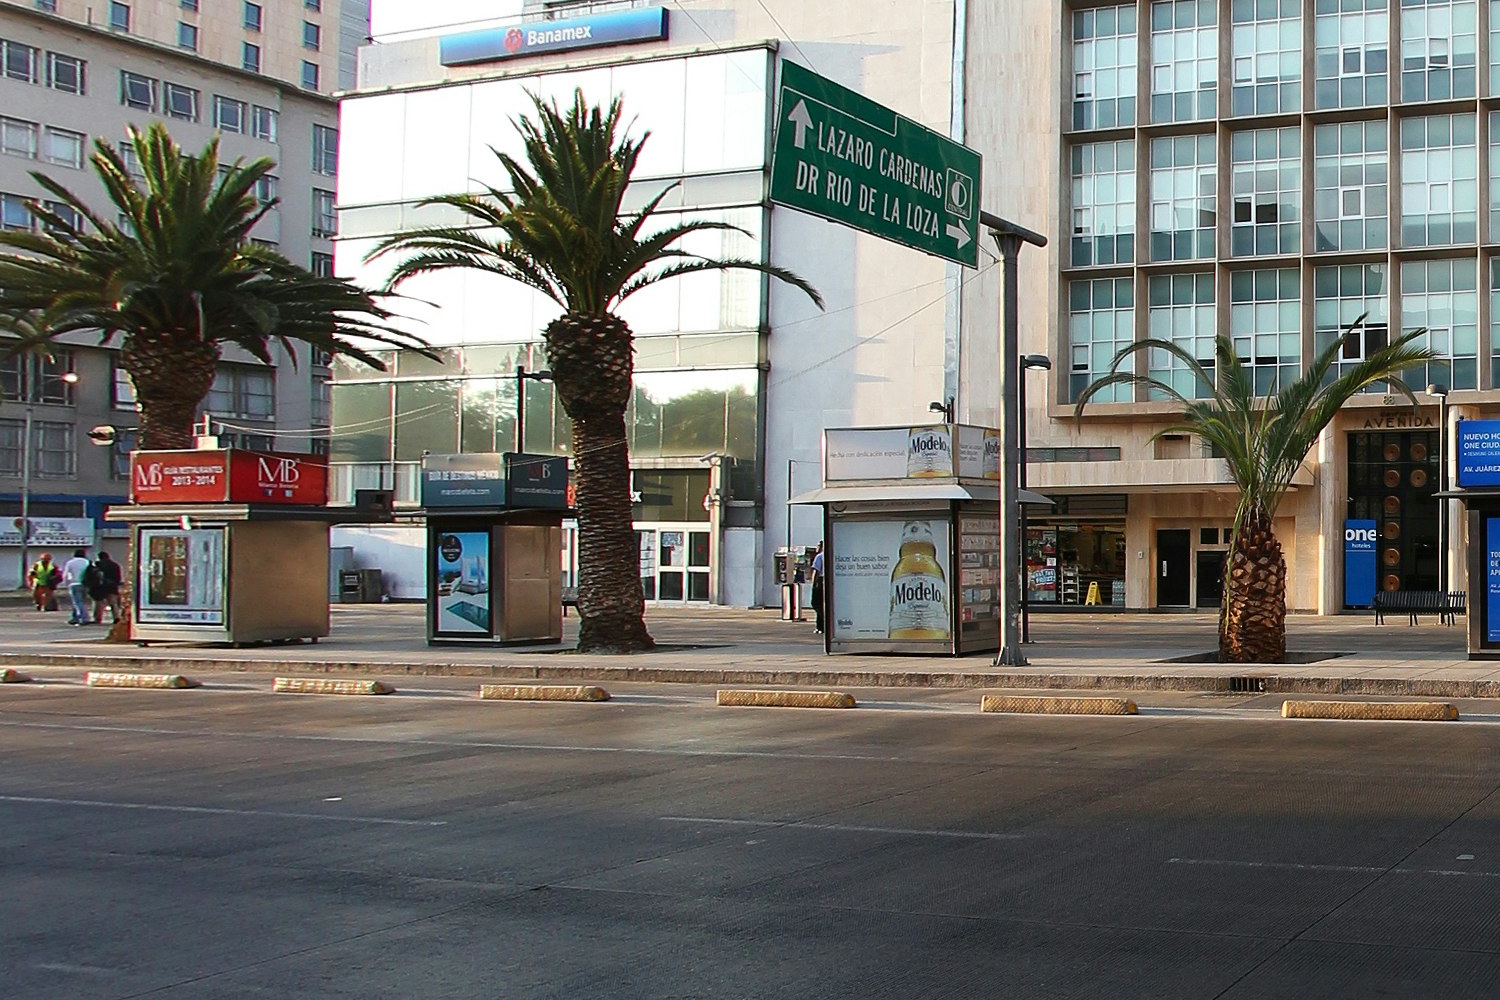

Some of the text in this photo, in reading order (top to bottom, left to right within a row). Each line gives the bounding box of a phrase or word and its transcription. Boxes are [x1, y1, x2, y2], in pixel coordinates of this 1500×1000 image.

[527, 25, 592, 46] Banamex
[817, 120, 944, 199] LAZARO CARDENAS
[795, 160, 940, 239] DR RIO DE LA LOZA
[1363, 415, 1434, 429] AVENIDA
[912, 435, 947, 454] Modelo
[1463, 433, 1490, 441] NUEVO
[137, 463, 162, 486] MB
[257, 457, 300, 483] MB
[1345, 529, 1377, 541] one
[895, 581, 942, 606] Modelo
